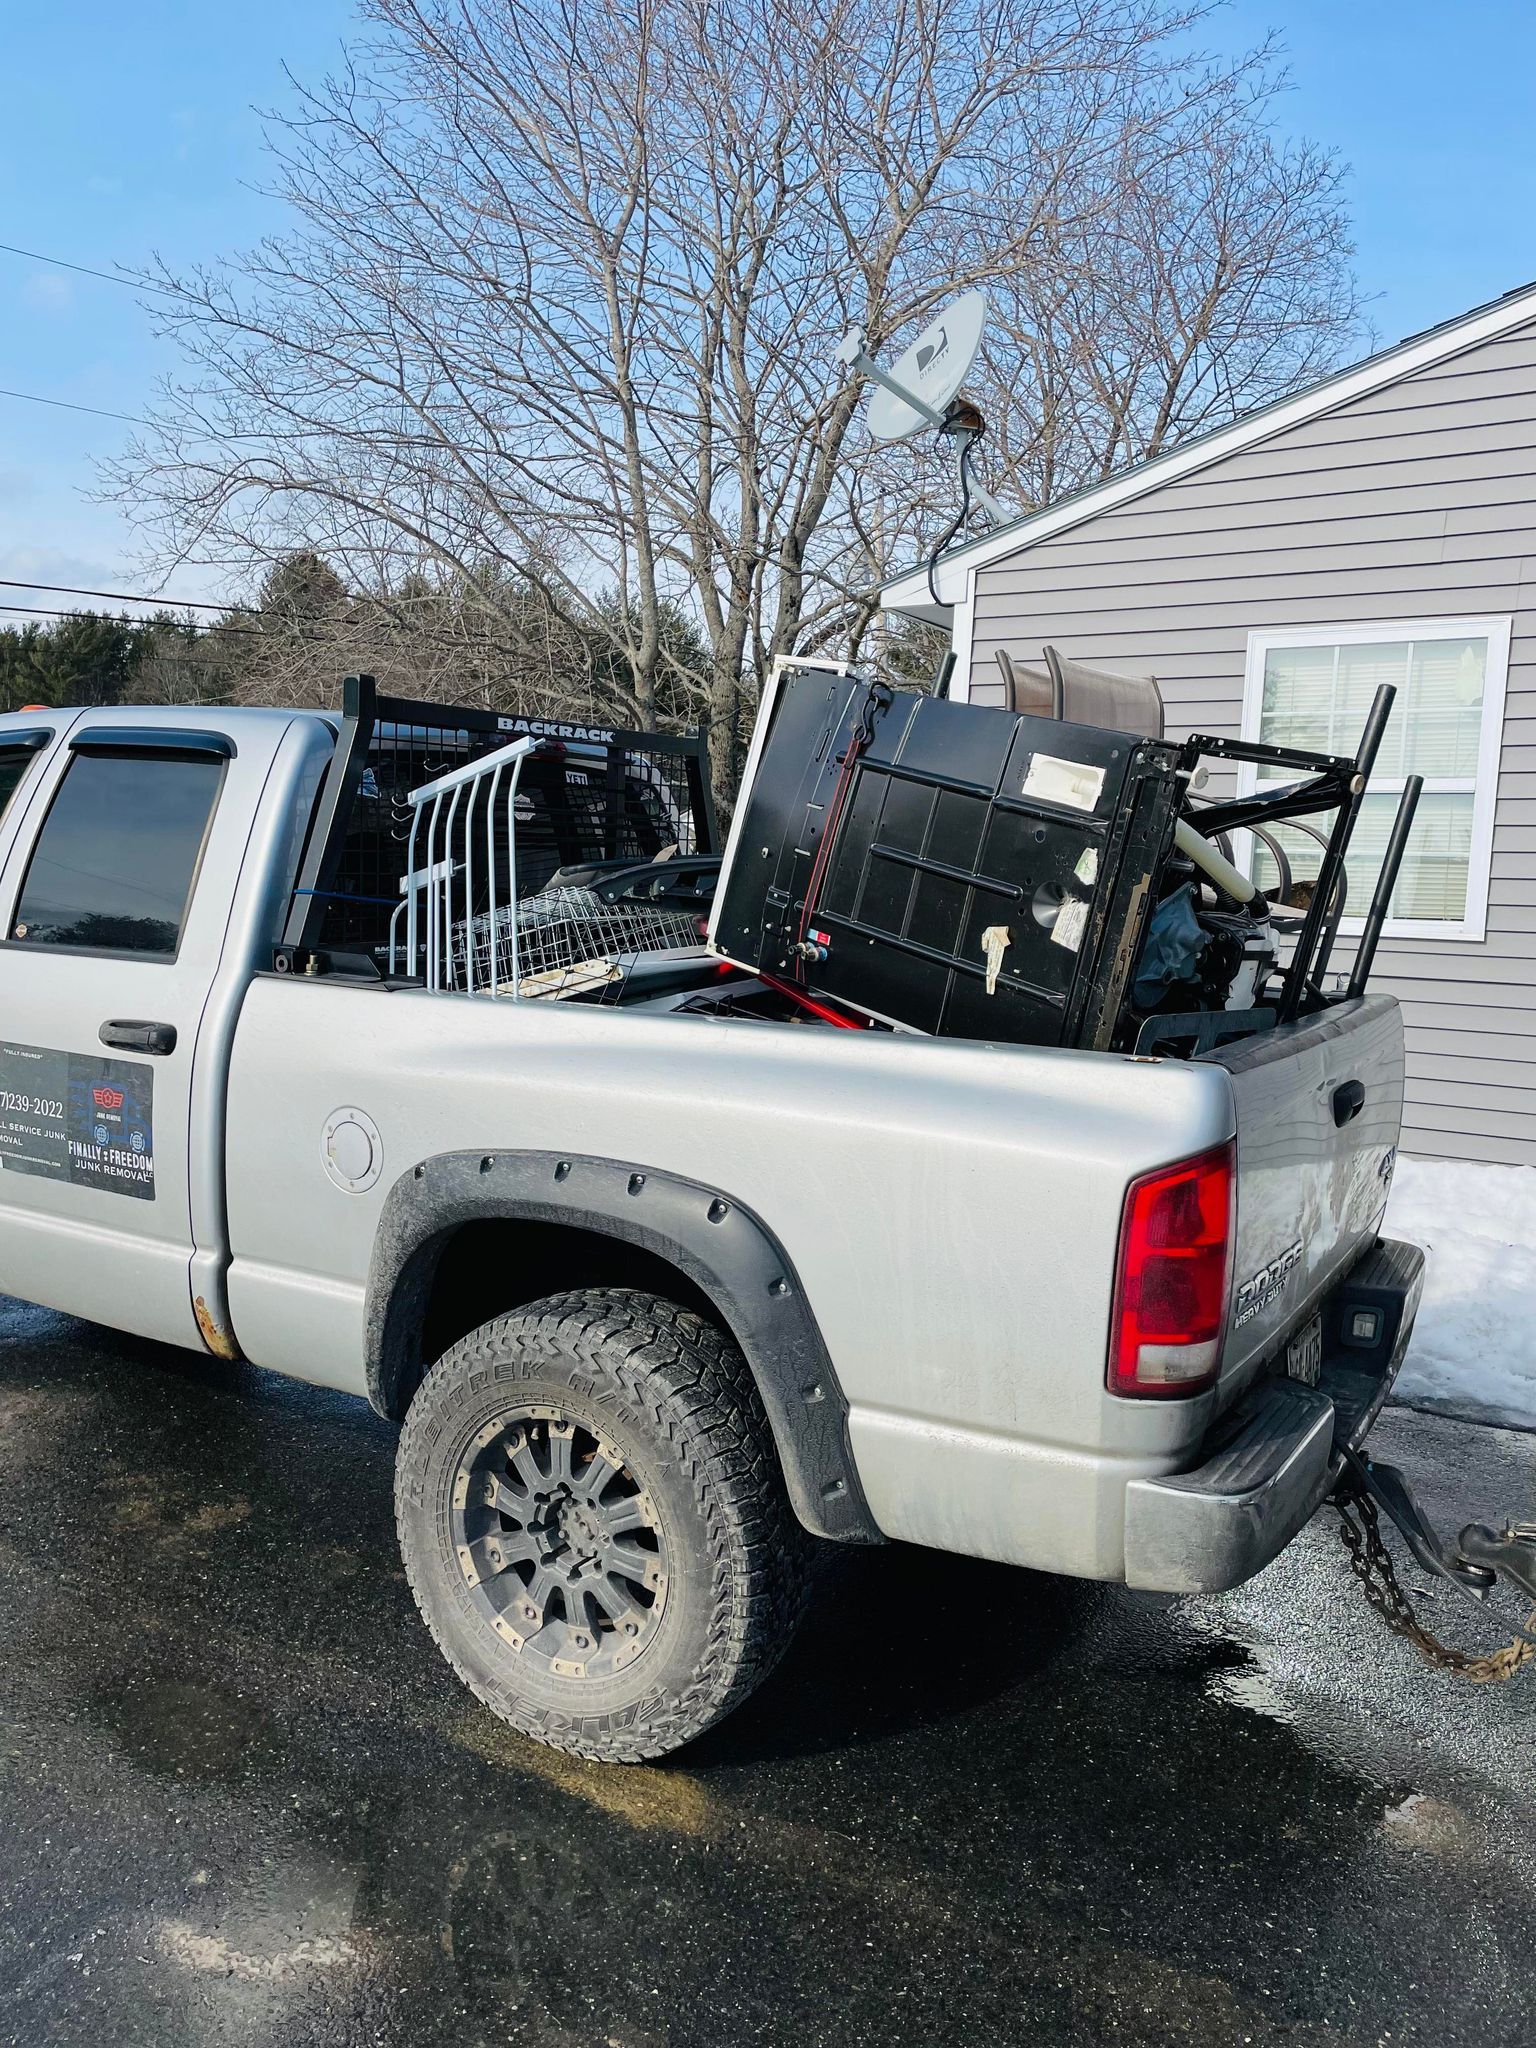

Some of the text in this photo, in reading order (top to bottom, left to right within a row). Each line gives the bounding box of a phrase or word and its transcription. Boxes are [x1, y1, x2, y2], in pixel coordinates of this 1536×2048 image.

[497, 716, 614, 743] BACKRACK
[566, 771, 588, 785] YETI
[9, 1122, 42, 1136] SERVICE
[44, 1129, 66, 1141] JUNK
[68, 1141, 153, 1171] FINALLY FREEDOM
[75, 1159, 101, 1173] JUNK
[104, 1165, 150, 1183] REMOVAL
[1235, 1277, 1288, 1330] HEAVY DUTY
